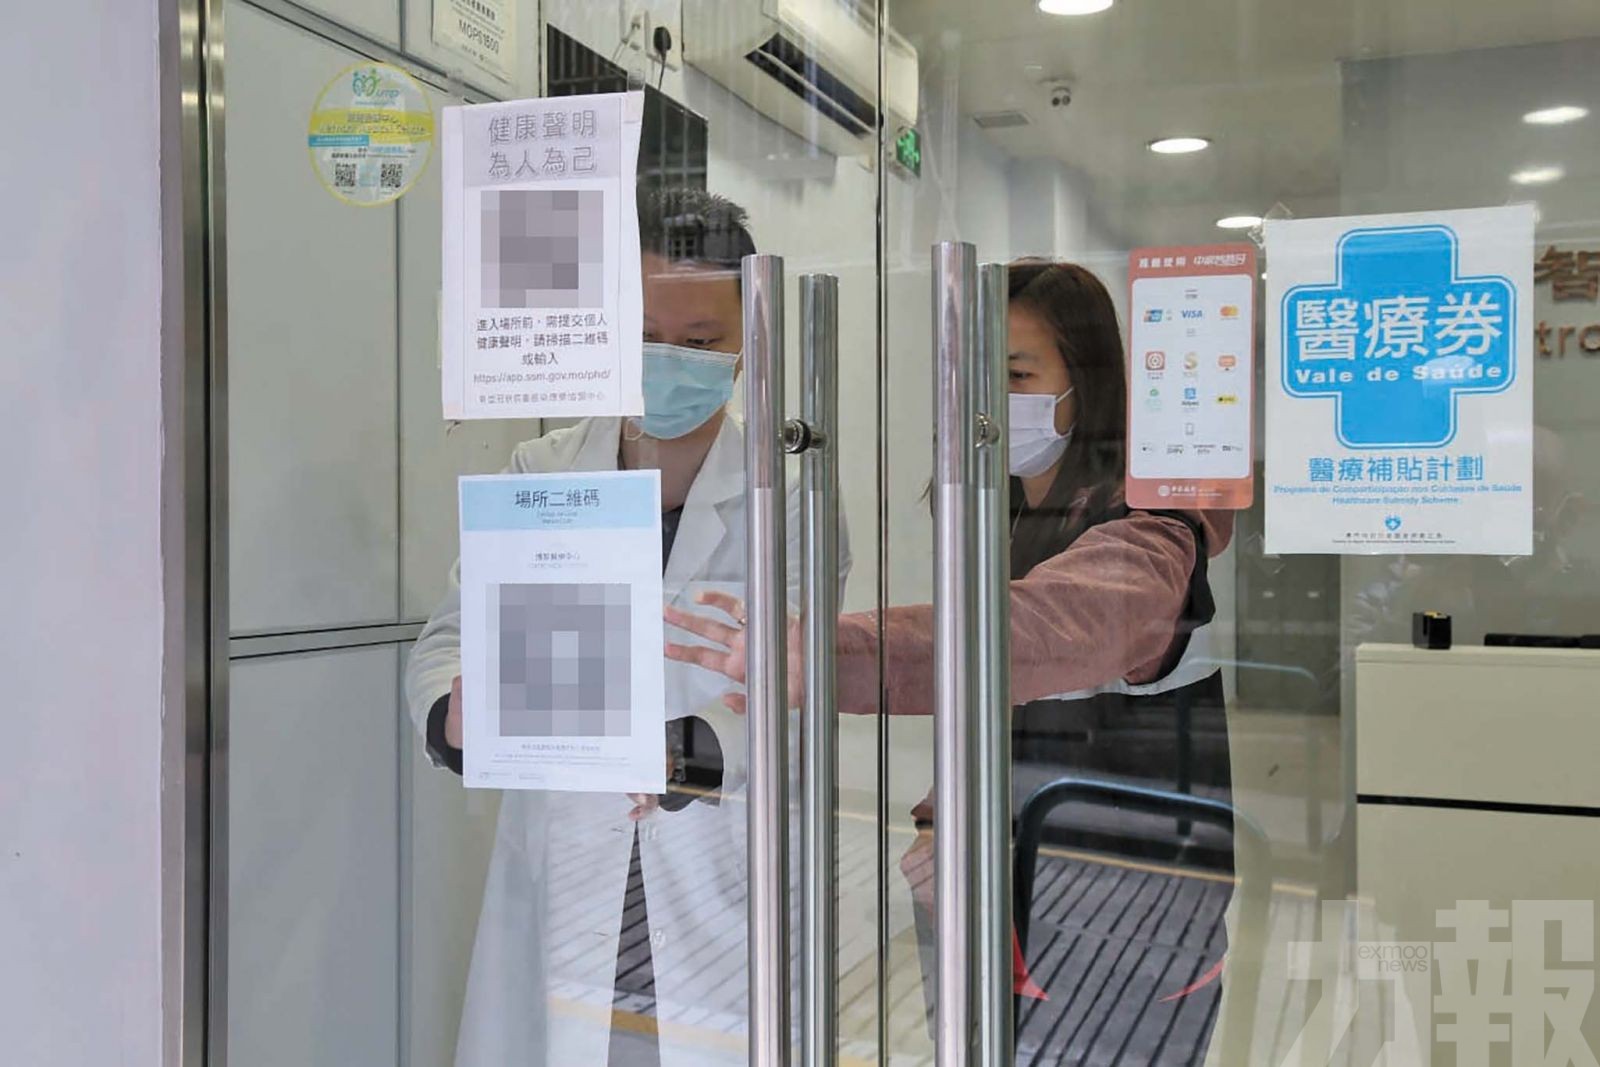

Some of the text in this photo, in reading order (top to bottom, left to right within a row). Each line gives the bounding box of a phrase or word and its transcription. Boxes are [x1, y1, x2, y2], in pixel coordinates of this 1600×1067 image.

[488, 109, 596, 143] 健康聲明
[488, 146, 596, 178] 為人為己
[1181, 309, 1203, 319] VISA
[1295, 292, 1503, 361] 醫療券
[521, 352, 559, 366] 或輸入
[1295, 363, 1502, 384] Vale de Saúde
[1308, 455, 1483, 482] 醫療補貼計劃
[514, 488, 600, 509] 場所二維碼
